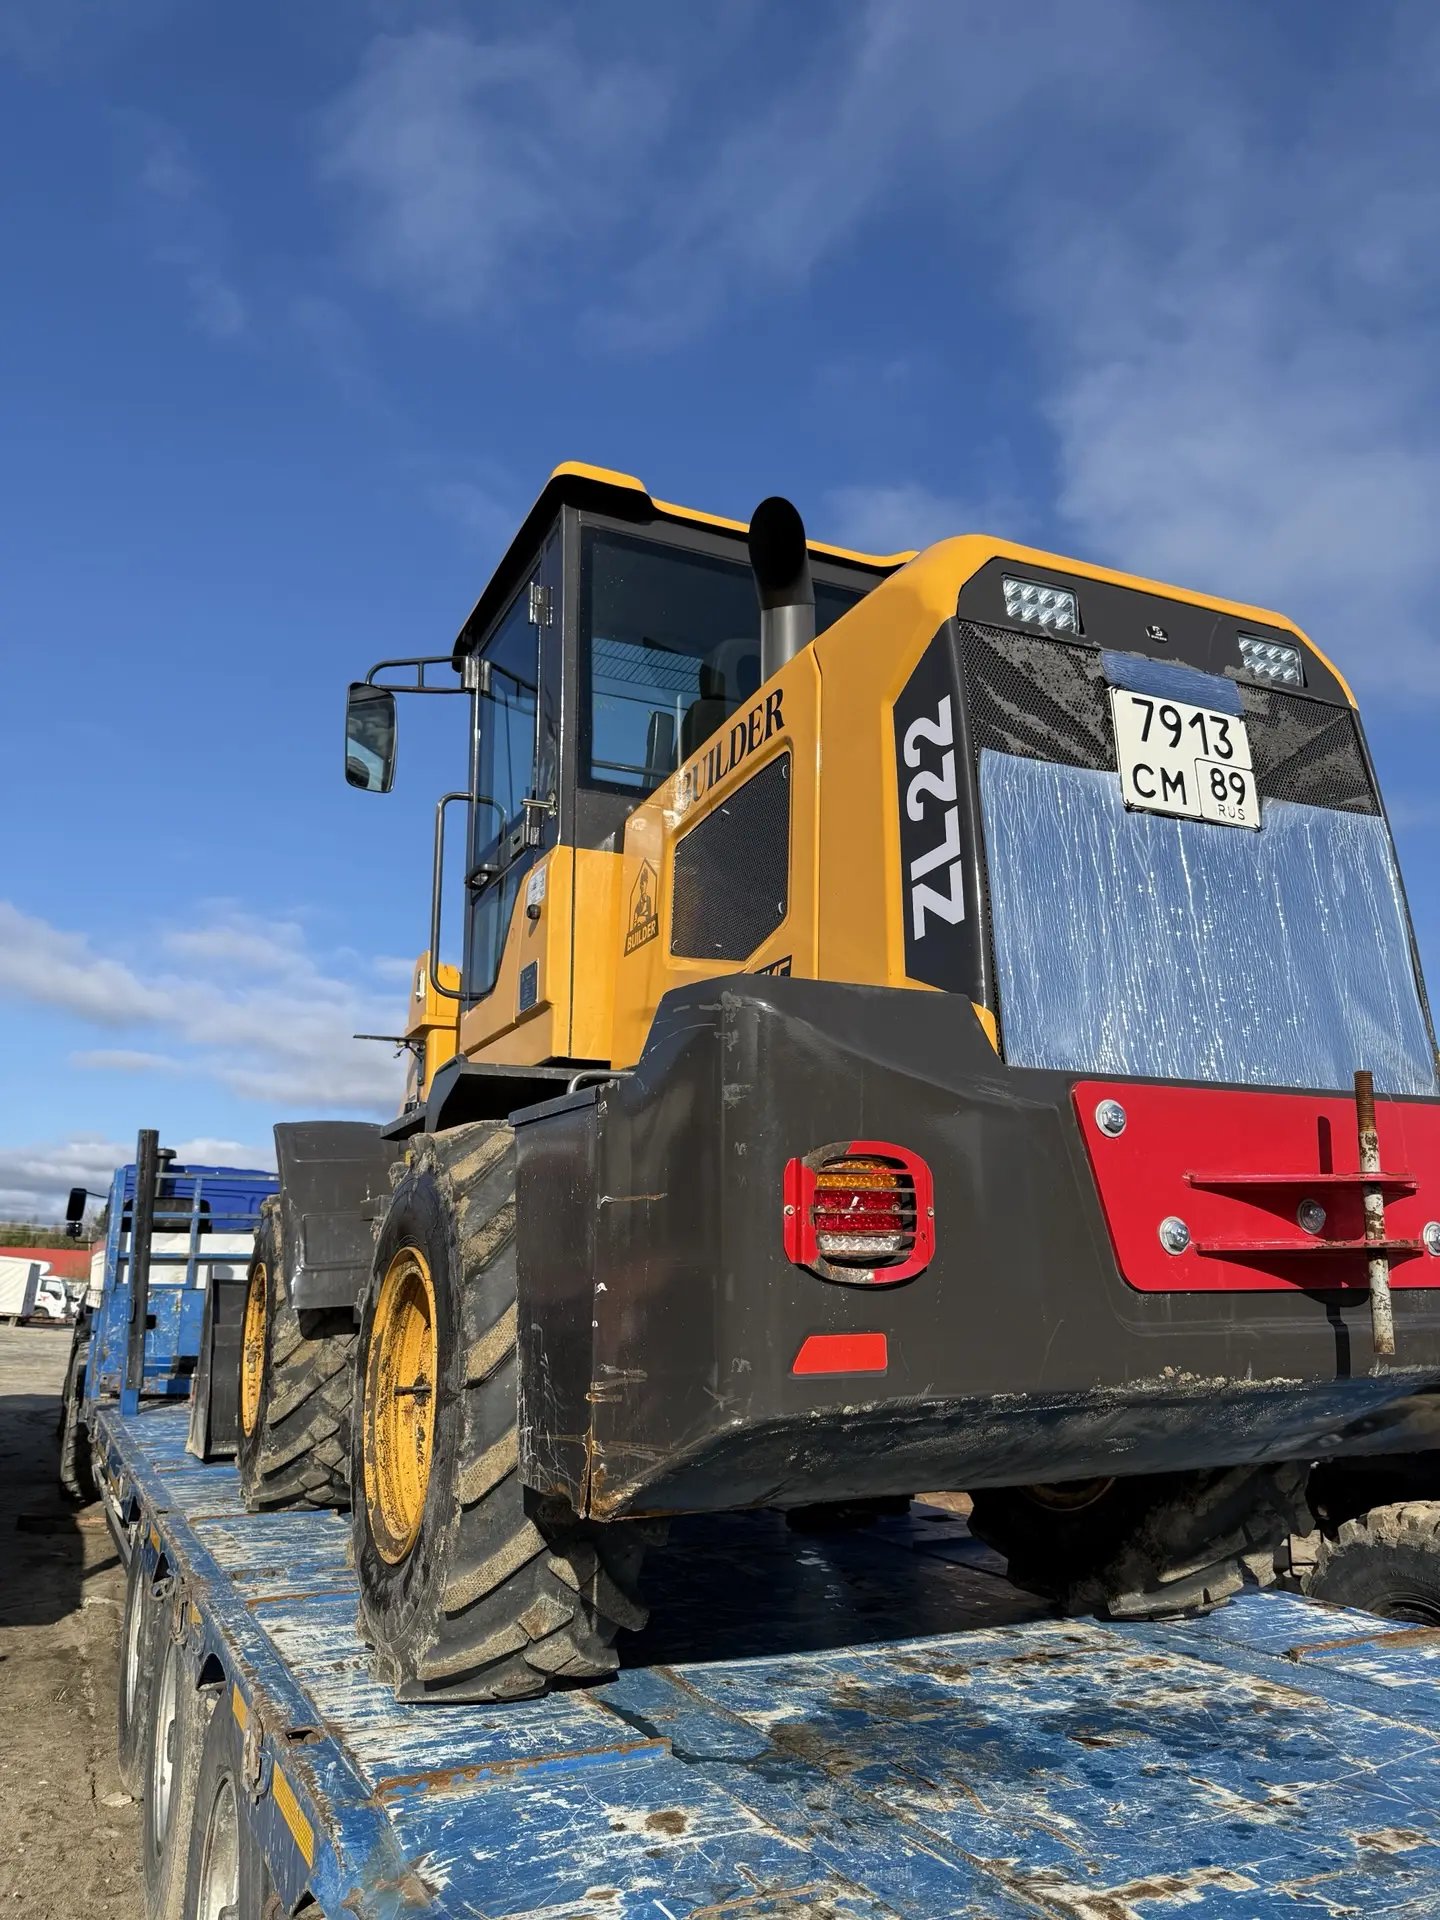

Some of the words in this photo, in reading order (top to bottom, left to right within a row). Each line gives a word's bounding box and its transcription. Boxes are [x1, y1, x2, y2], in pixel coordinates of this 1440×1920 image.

[1131, 697, 1234, 760] 7913
[1209, 767, 1246, 805] 89
[903, 694, 965, 941] ZL22
[1217, 804, 1246, 821] RUS
[626, 919, 656, 952] BUILDER
